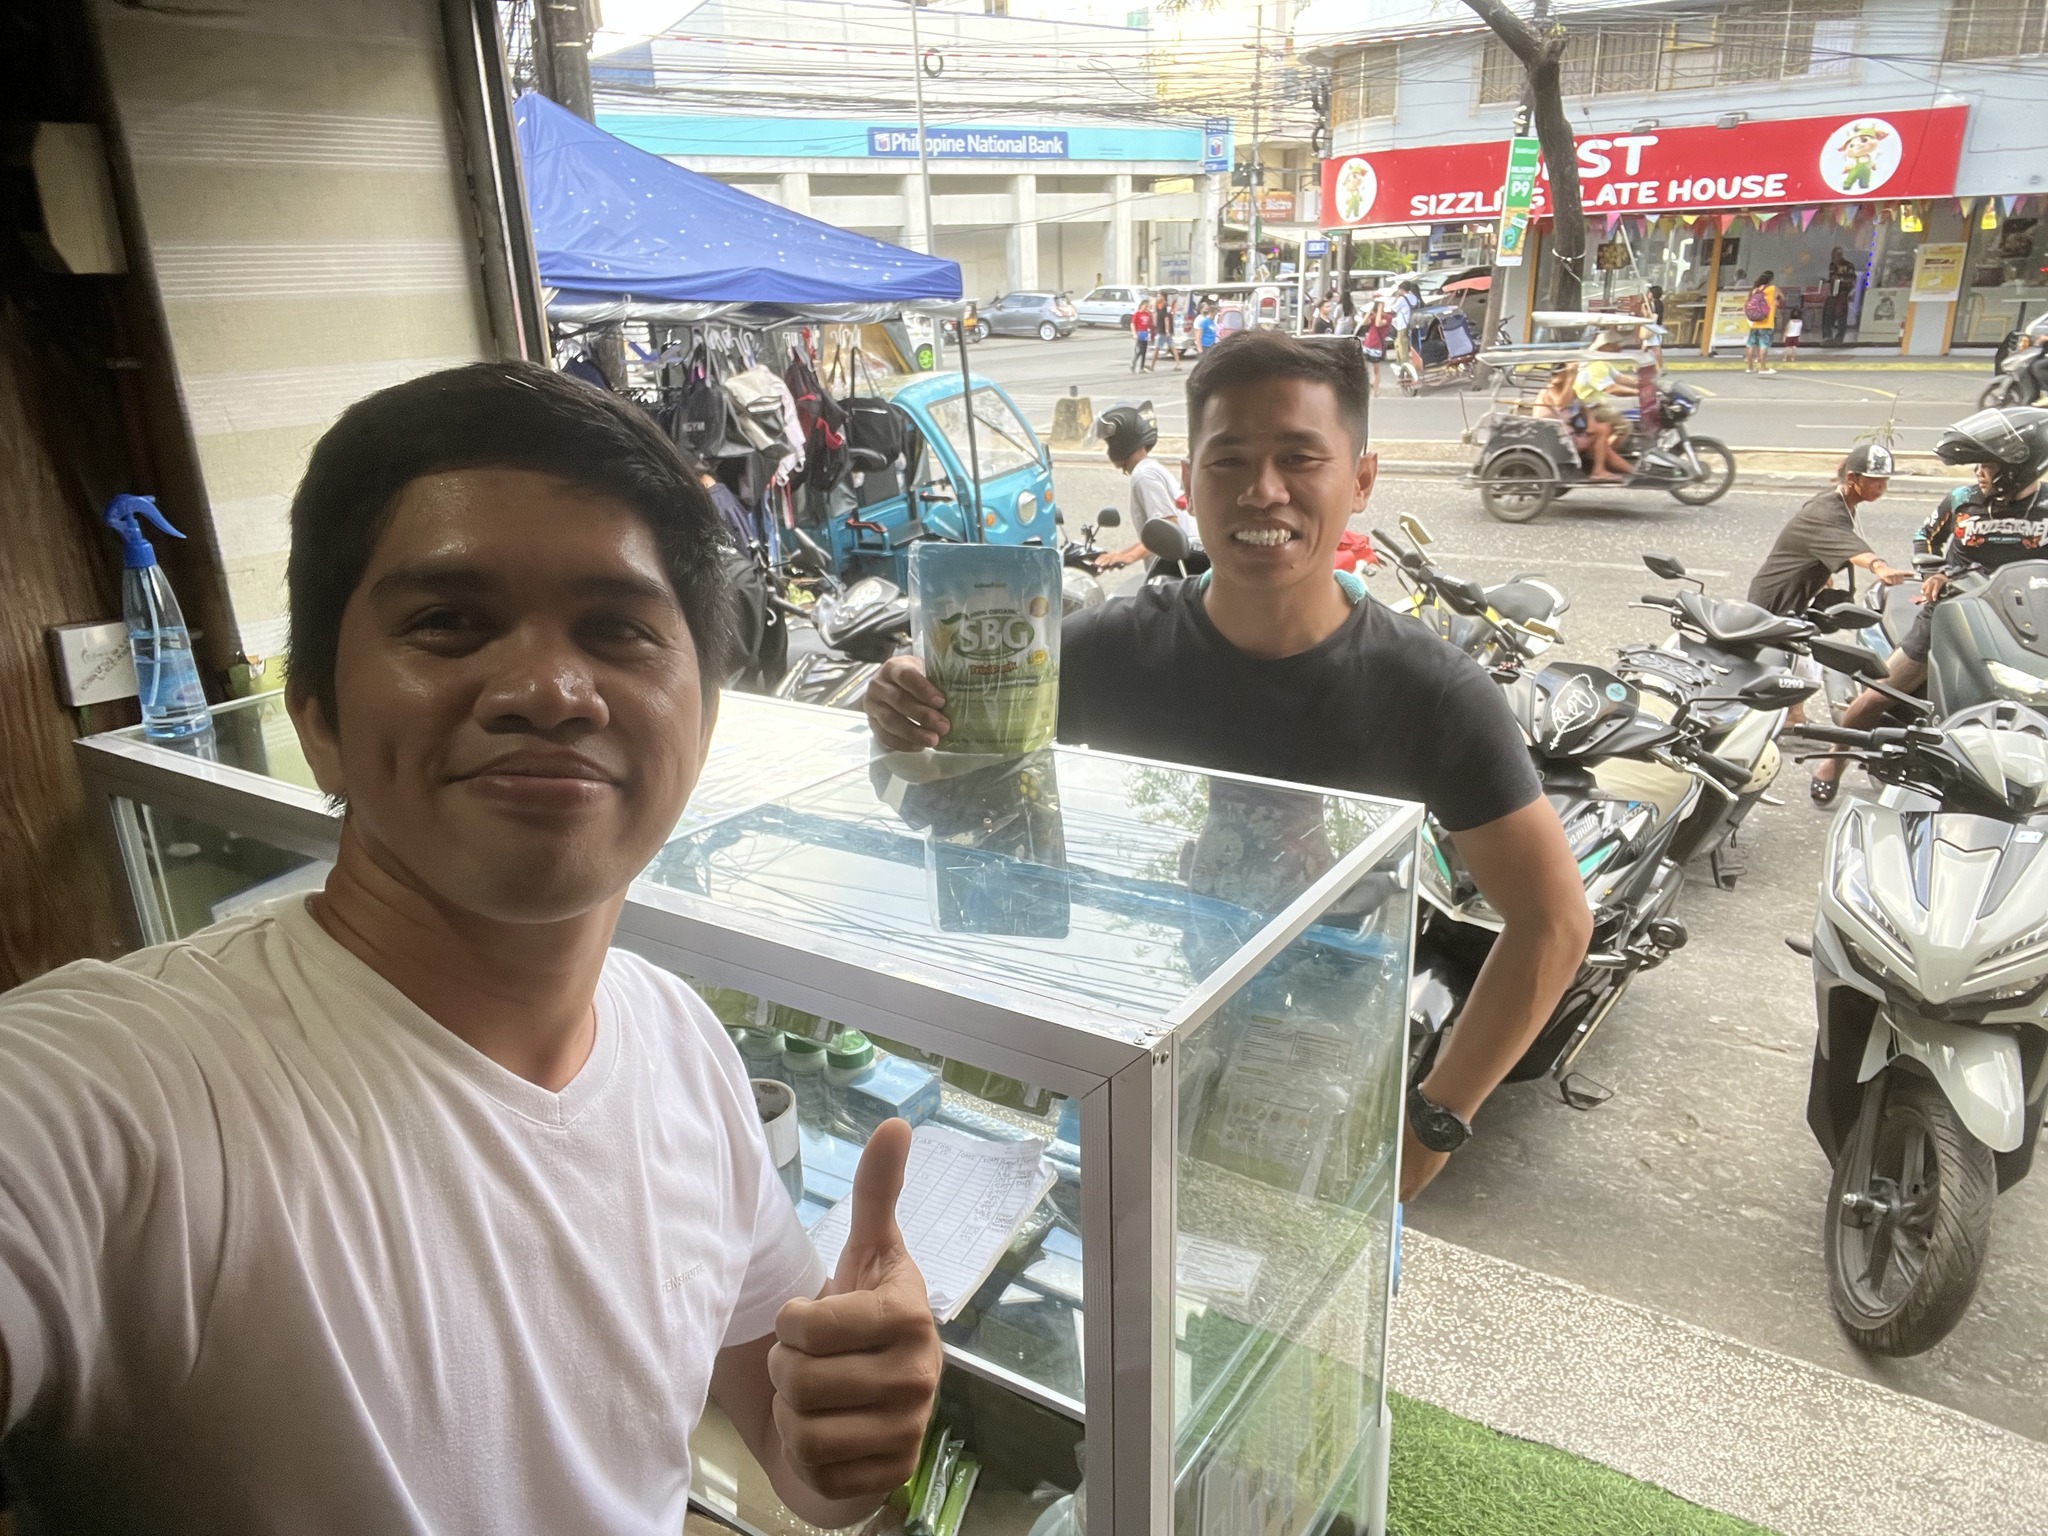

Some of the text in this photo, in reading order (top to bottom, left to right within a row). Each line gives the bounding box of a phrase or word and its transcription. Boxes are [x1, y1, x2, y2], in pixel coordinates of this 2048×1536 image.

[892, 132, 1064, 157] Philppine National Bank
[1534, 135, 1659, 182] ST
[1410, 173, 1789, 217] SIZZLIG LATE HOUSE
[959, 616, 1030, 653] SBG
